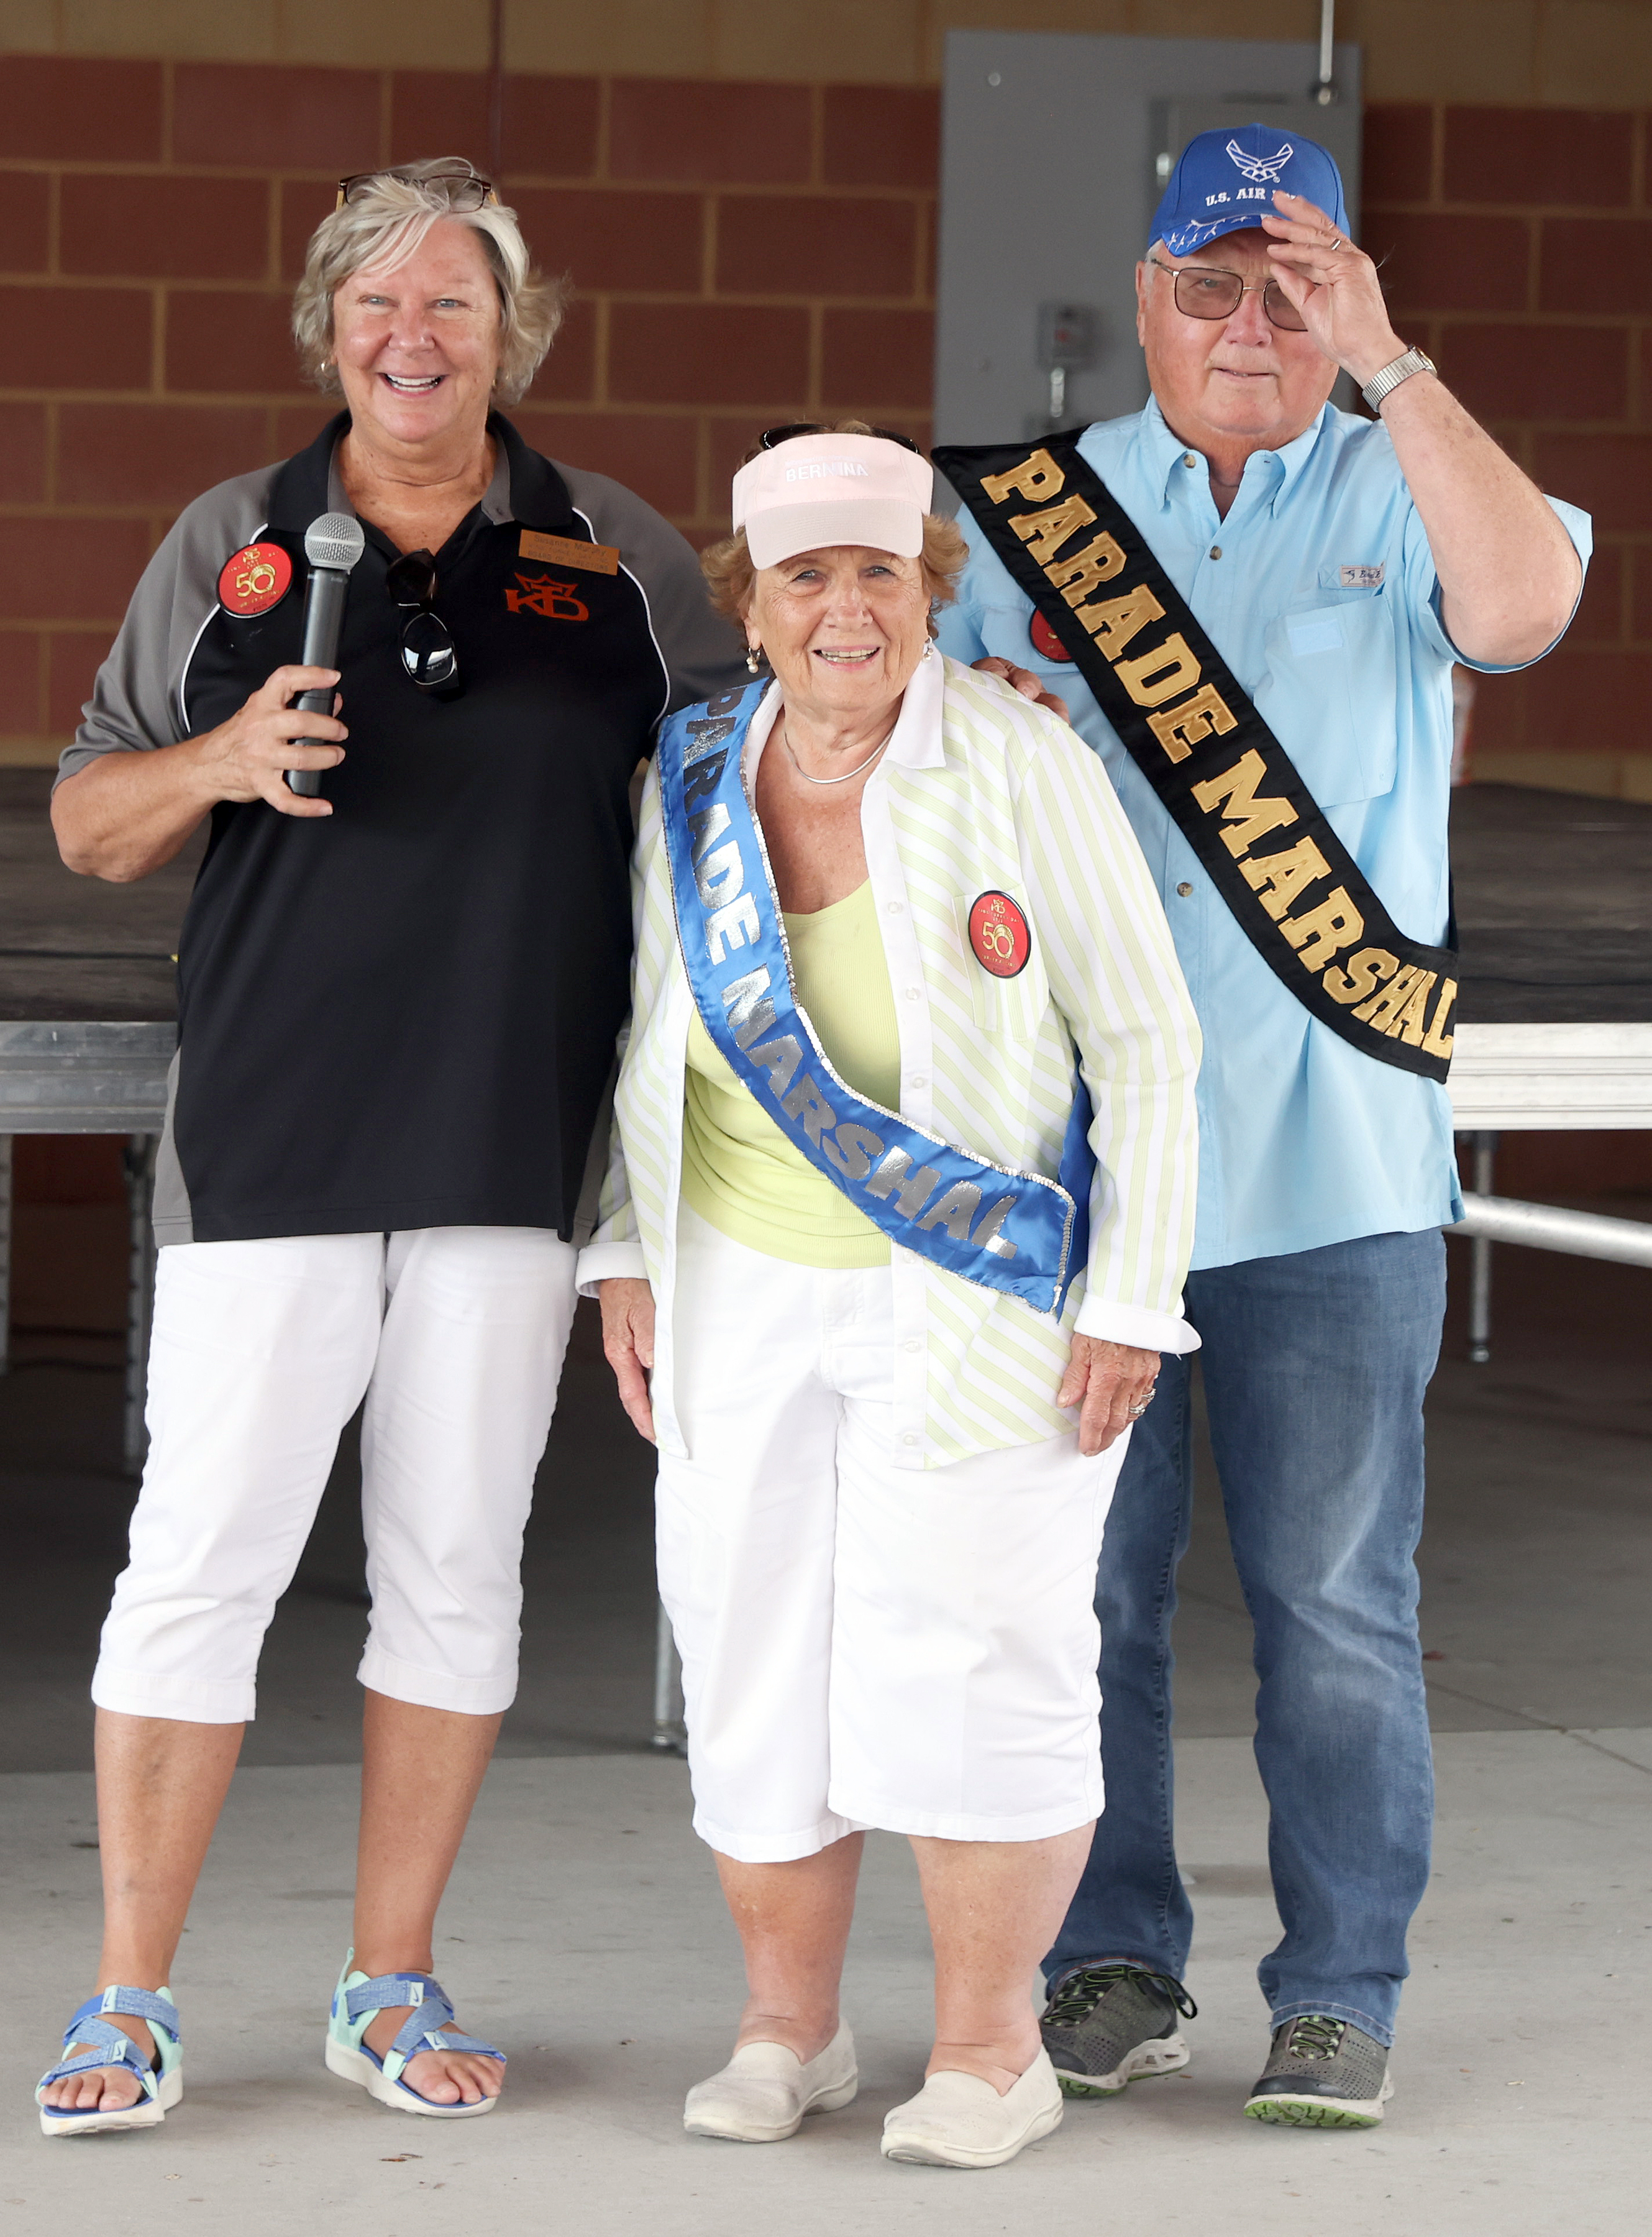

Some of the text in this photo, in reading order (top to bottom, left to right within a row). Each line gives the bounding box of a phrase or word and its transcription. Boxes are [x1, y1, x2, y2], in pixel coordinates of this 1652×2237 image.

[1205, 192, 1231, 206] U.S.
[1236, 187, 1266, 200] AIR
[785, 462, 869, 482] BERNINA
[236, 564, 275, 597] 50
[980, 447, 1458, 1059] PARADE MARSHAL
[983, 921, 1015, 959] 50
[682, 685, 1018, 1259] PARADE MARSHAL
